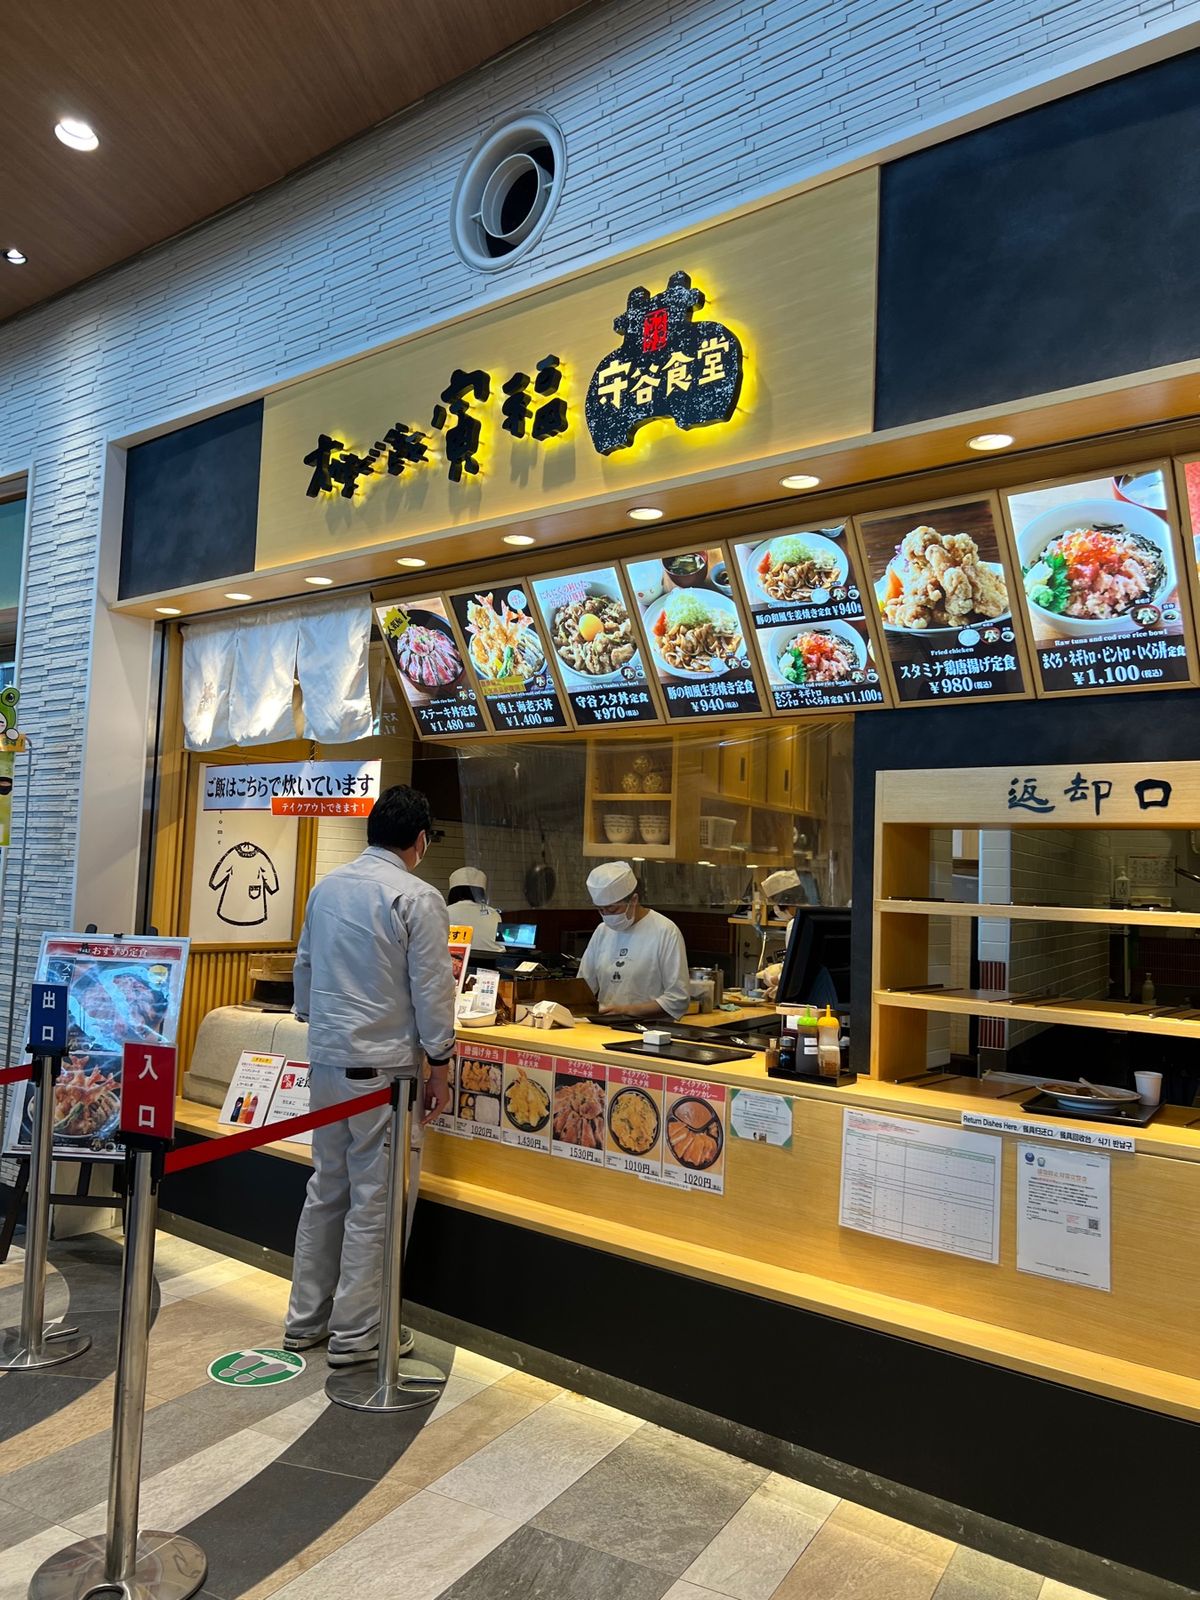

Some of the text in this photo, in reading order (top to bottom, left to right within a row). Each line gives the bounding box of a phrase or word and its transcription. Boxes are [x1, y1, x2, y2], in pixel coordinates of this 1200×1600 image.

[598, 336, 729, 410] 守谷食堂
[1148, 629, 1168, 637] bowl
[1072, 665, 1140, 685] ¥1,100
[667, 680, 755, 700] 豚の和風生姜焼き定食
[929, 677, 974, 694] ¥980
[517, 699, 553, 712] 海老天丼
[576, 693, 648, 708] 守谷 スタ丼定食
[691, 698, 725, 712] ¥940
[420, 705, 478, 720] ステーキ丼定食
[593, 706, 625, 720] ¥970
[430, 720, 464, 732] ¥1,480
[506, 713, 542, 727] ¥1,400
[207, 774, 373, 797] ご飯はこちらで炊いています
[1008, 772, 1172, 816] 返却口
[282, 802, 366, 813] テイクアウトできます！
[92, 946, 148, 957] おすすめ定食
[42, 990, 55, 1041] 出口
[568, 1060, 594, 1069] テイクアウト
[621, 1070, 649, 1080] テイクアウト
[138, 1054, 159, 1128] 入口
[680, 1079, 710, 1089] テイクアウト
[673, 1085, 718, 1098] チキンカツカレー
[963, 1115, 982, 1125] Return
[982, 1118, 1002, 1128] Dishes
[1003, 1121, 1017, 1130] Here
[471, 1125, 493, 1137] 1020円
[569, 1147, 594, 1161] 1530円
[624, 1159, 650, 1175] 1010円
[684, 1173, 712, 1189] 1020円
